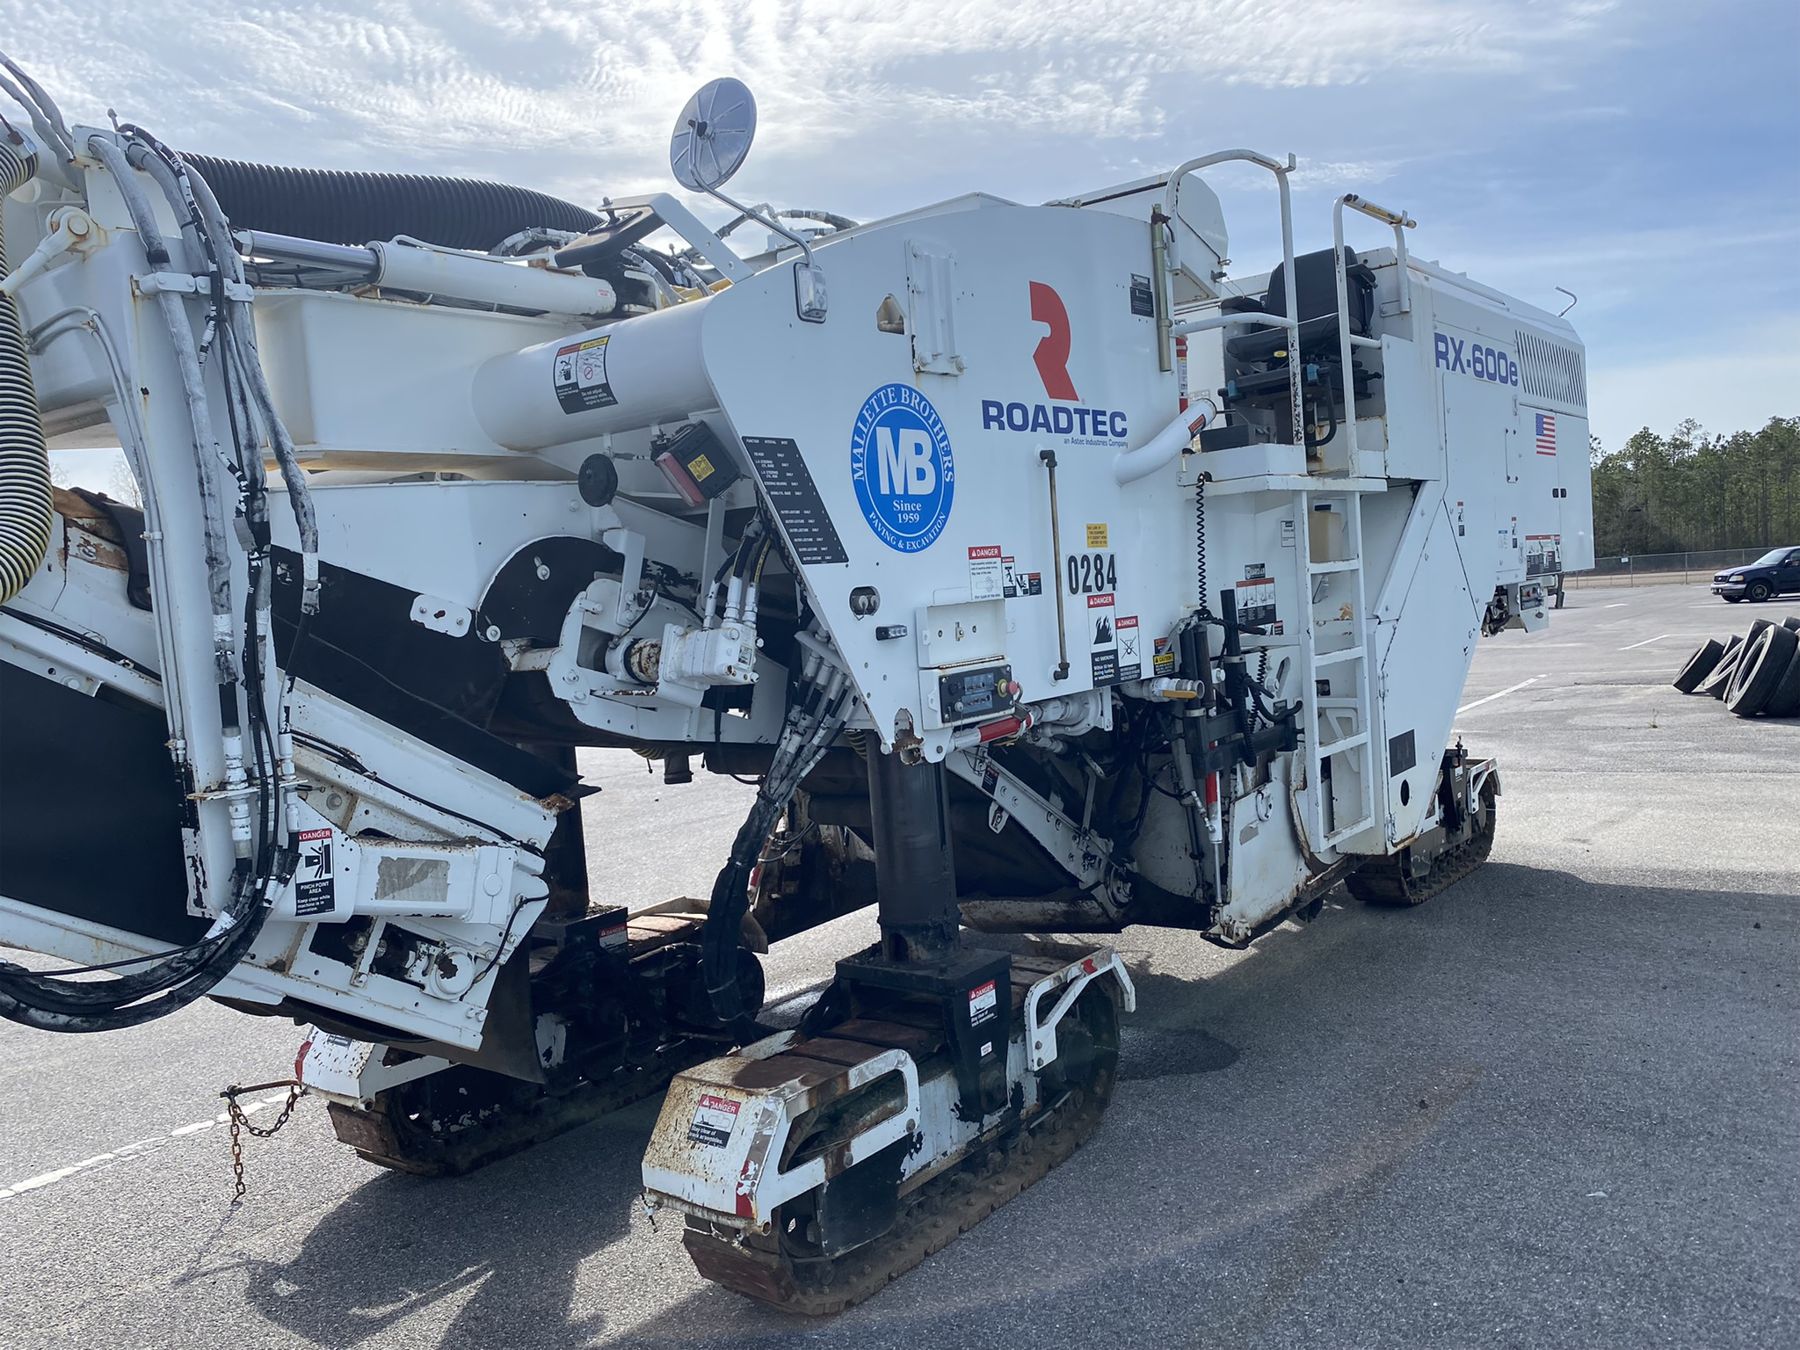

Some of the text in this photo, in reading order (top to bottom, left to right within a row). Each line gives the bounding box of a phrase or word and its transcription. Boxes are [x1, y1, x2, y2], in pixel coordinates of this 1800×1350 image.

[982, 400, 1128, 438] ROADTEC
[853, 387, 897, 481] MALLETTE
[901, 387, 954, 483] BROTHERS
[1071, 437, 1085, 445] Astec
[1108, 439, 1129, 449] Company
[875, 426, 936, 495] MB
[893, 500, 922, 511] Since
[897, 513, 920, 523] 1959
[869, 511, 896, 545] PAVING
[898, 540, 905, 549] &
[906, 512, 947, 550] EXCAVATION
[976, 548, 999, 557] DANGER
[1067, 554, 1117, 595] 0284
[1094, 596, 1112, 605] DANGER
[302, 830, 331, 840] DANGER
